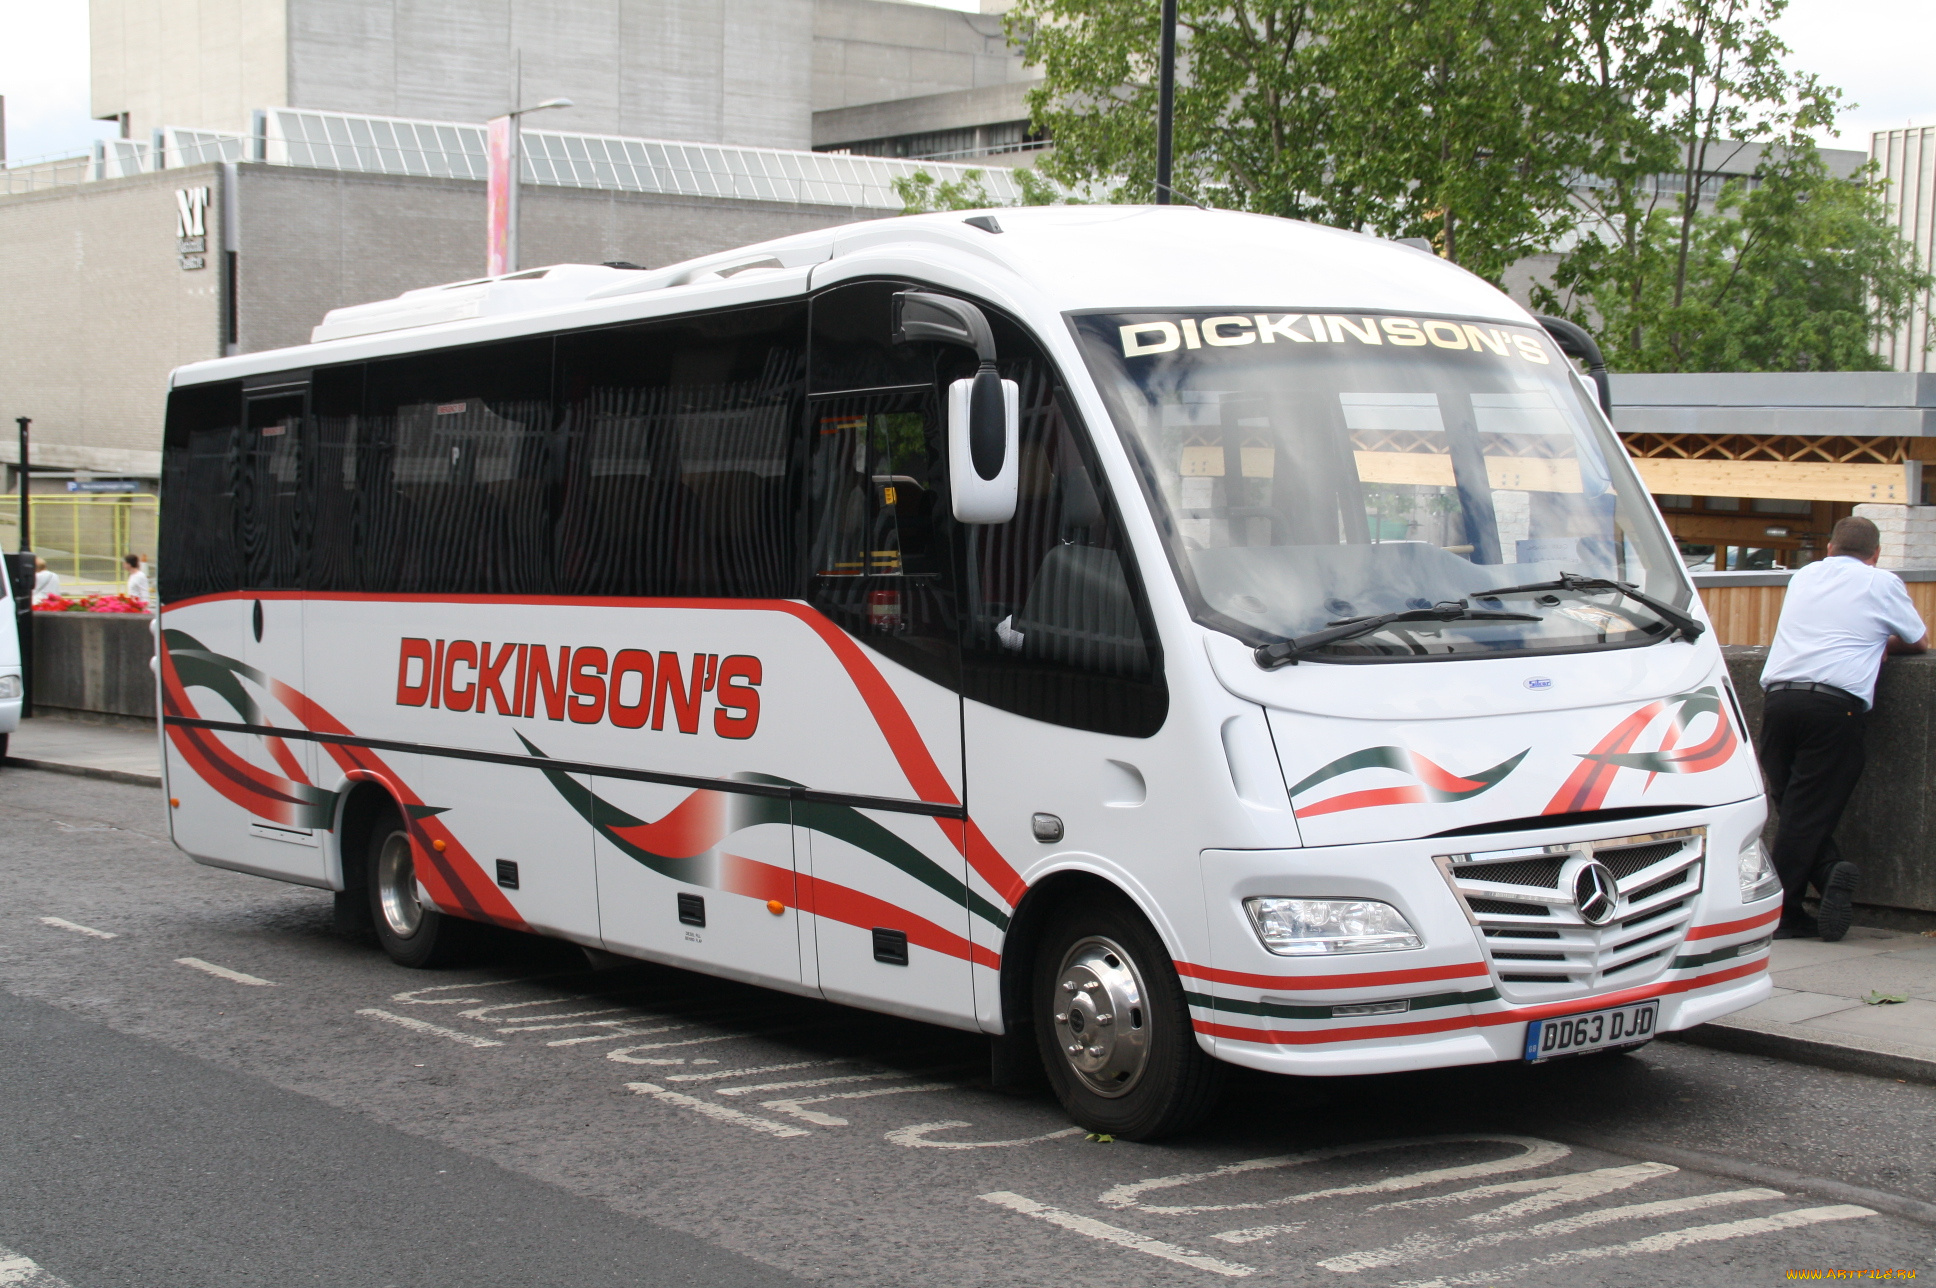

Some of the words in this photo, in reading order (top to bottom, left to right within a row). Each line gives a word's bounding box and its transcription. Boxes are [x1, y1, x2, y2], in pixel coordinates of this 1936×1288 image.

[175, 187, 208, 237] NT
[1118, 313, 1551, 365] DICKINSON'S
[396, 637, 763, 740] DICKINSON'S
[1542, 1015, 1604, 1051] DD63
[1610, 1007, 1653, 1040] DJD
